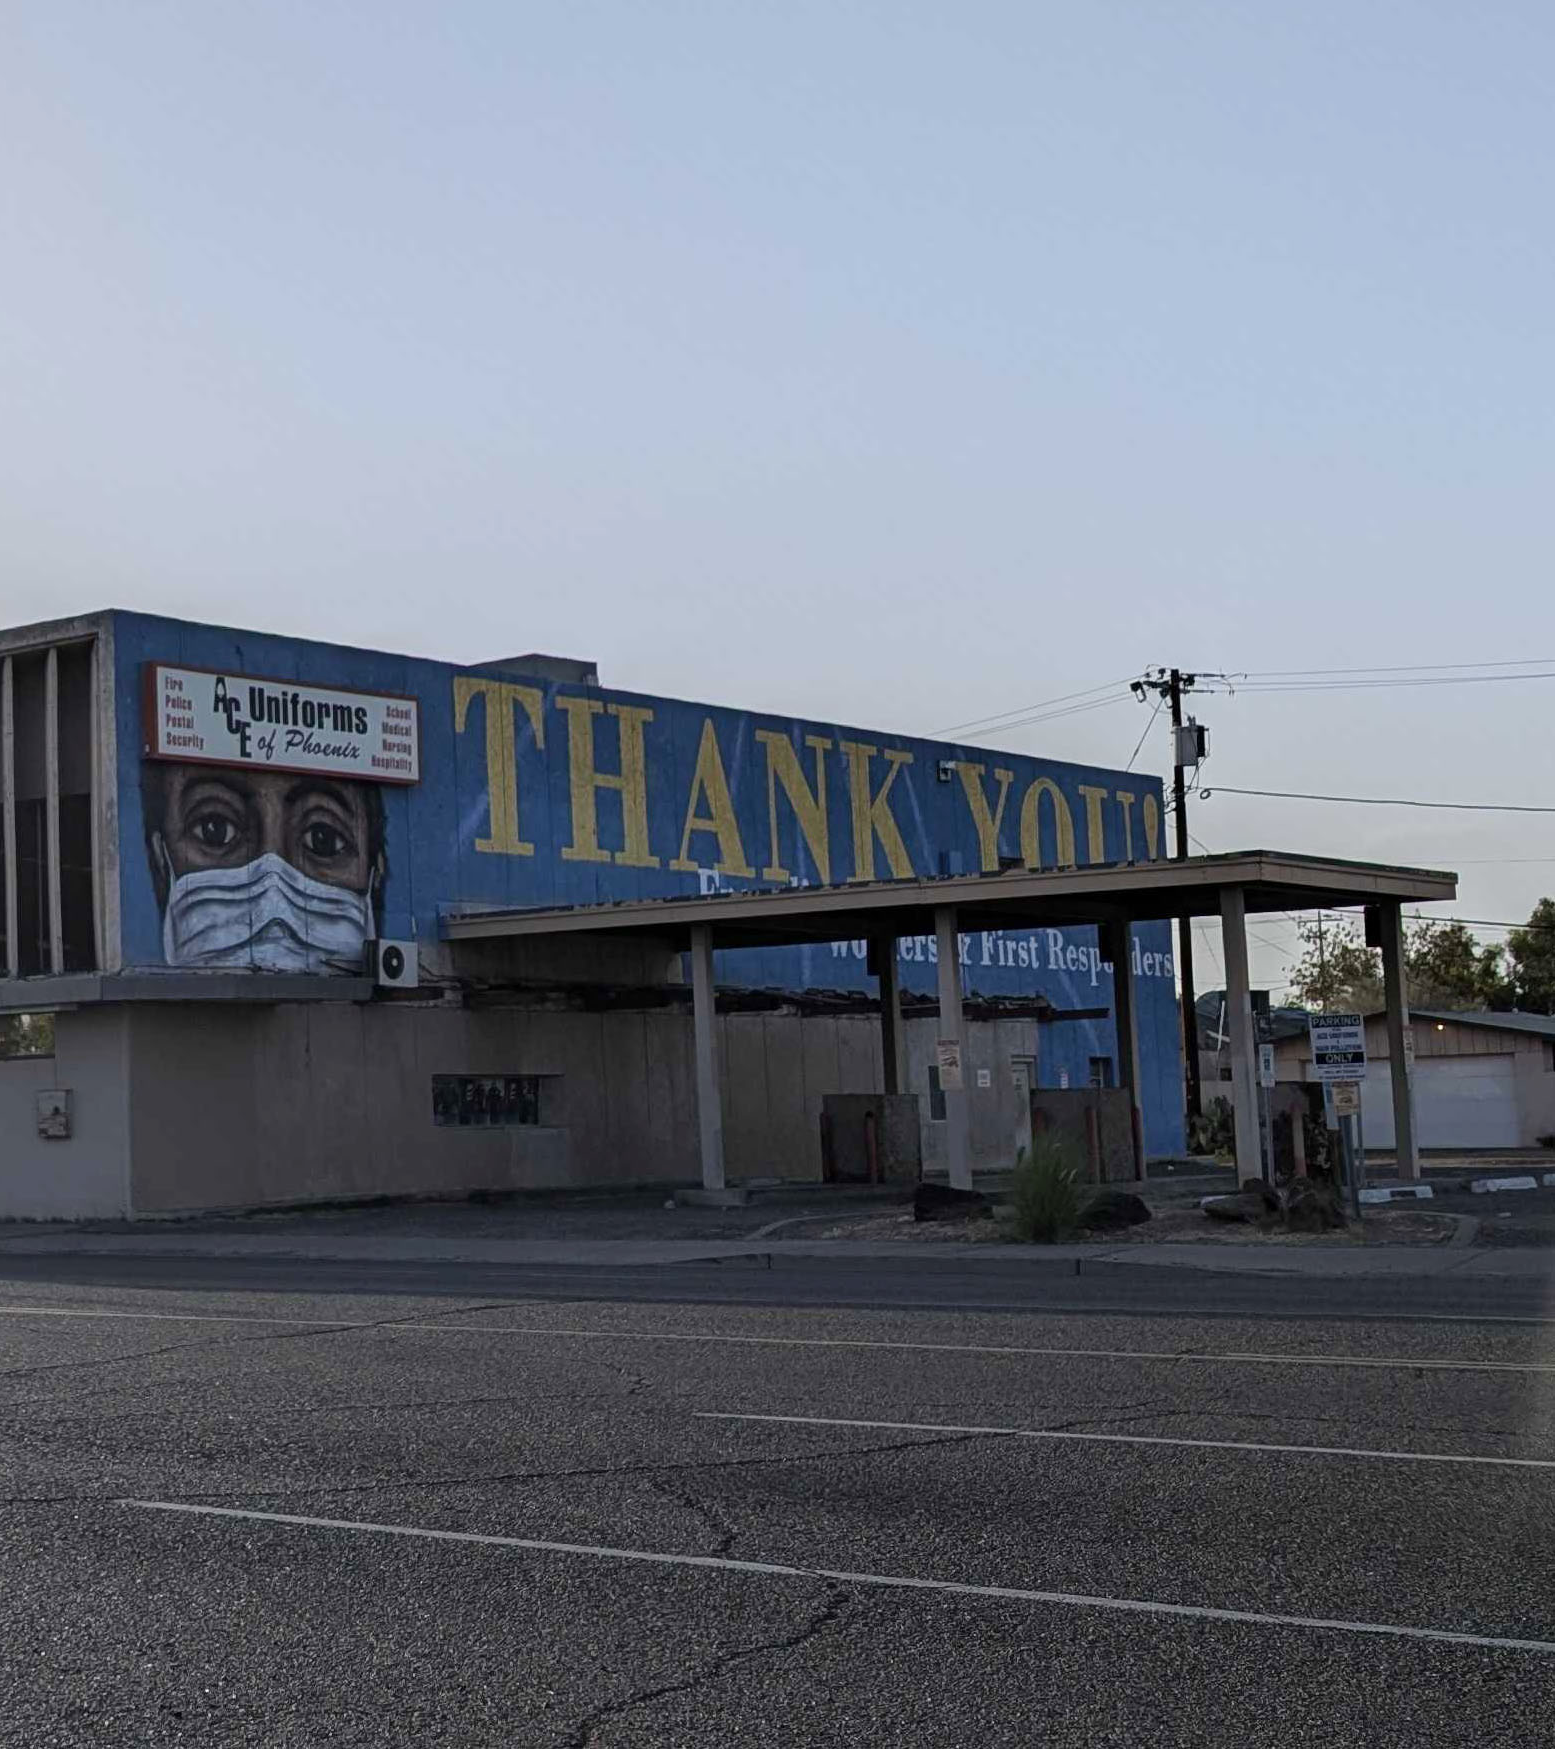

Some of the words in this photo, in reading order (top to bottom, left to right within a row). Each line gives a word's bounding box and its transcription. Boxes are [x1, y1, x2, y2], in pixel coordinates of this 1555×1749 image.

[165, 676, 183, 692] Fire
[166, 694, 193, 711] Police
[249, 686, 368, 735] Uniforms
[166, 713, 194, 729] Postal
[386, 705, 412, 721] School
[382, 722, 412, 737] Medical
[166, 731, 204, 751] Security
[257, 729, 276, 760] of
[285, 729, 361, 759] Phoenix
[453, 676, 914, 884] THANK
[955, 761, 1158, 872] YOU!
[979, 930, 1040, 969] First
[1047, 927, 1172, 987] Respders
[1312, 1015, 1360, 1027] PARKING
[1325, 1053, 1353, 1064] ONLY
